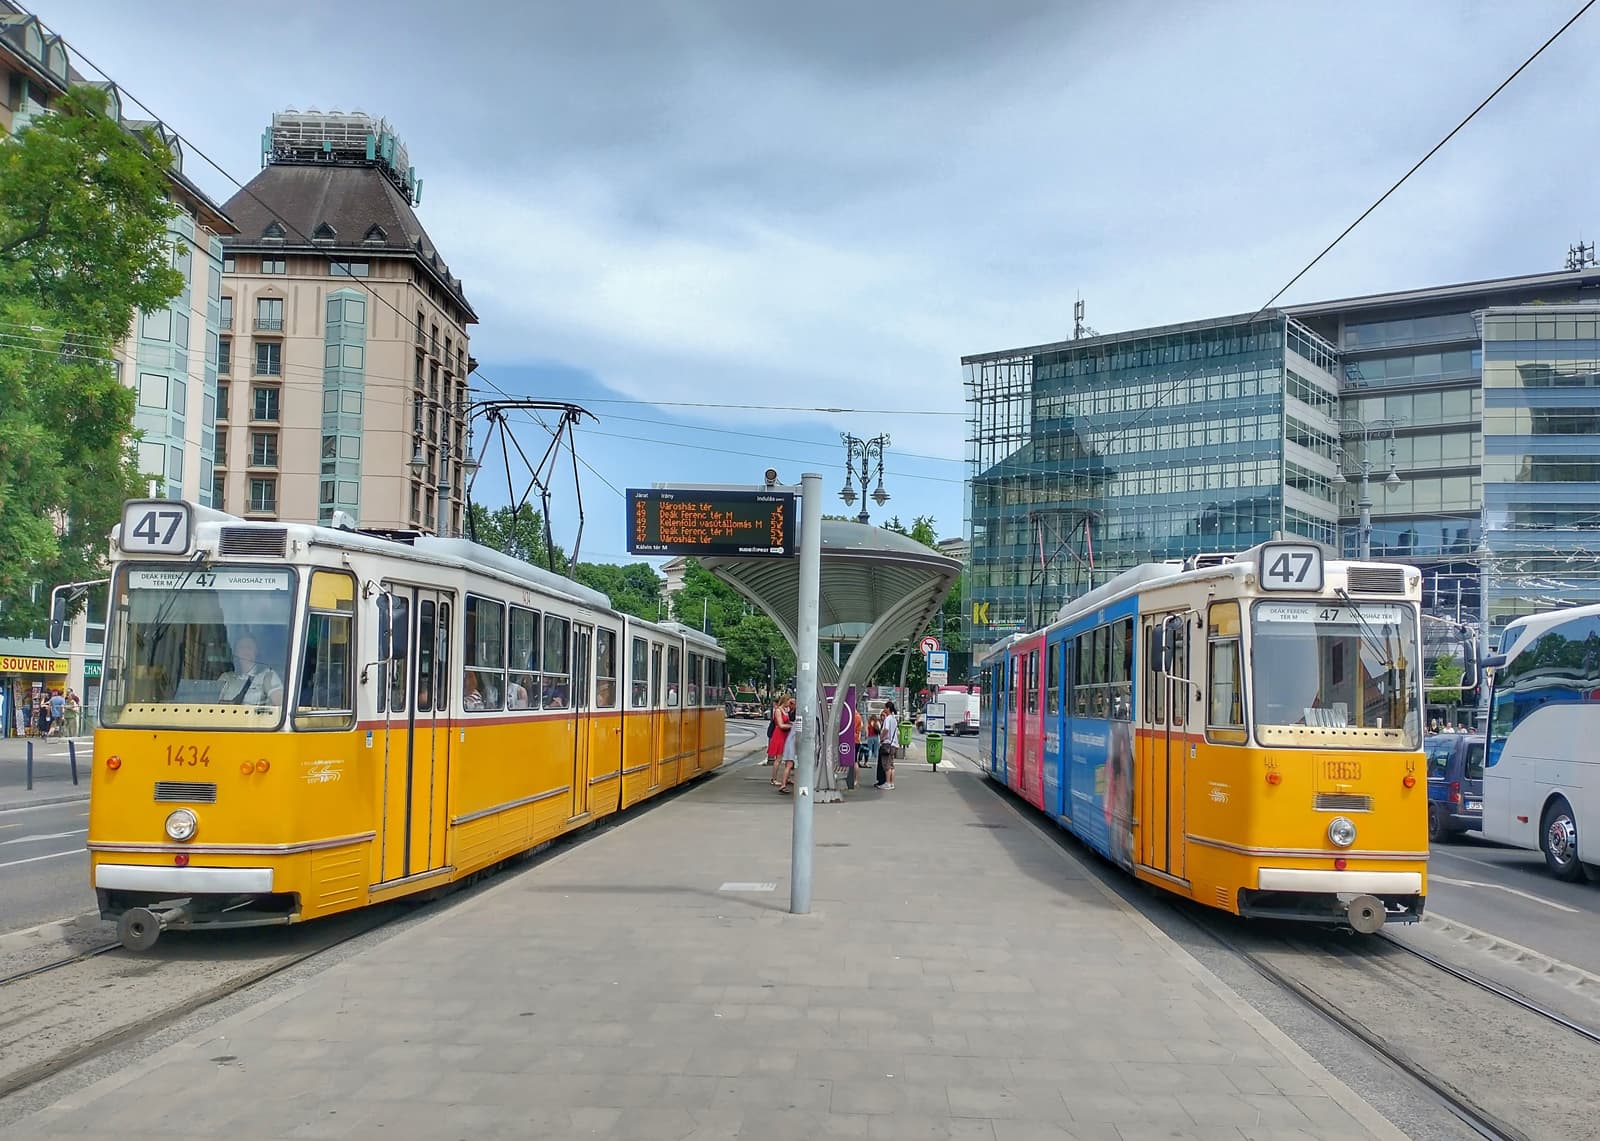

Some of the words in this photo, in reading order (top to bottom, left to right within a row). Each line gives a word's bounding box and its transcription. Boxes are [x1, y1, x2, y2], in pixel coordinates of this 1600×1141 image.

[700, 503, 713, 511] tér
[681, 511, 707, 520] Ferenc
[710, 512, 723, 520] tér
[726, 512, 733, 520] M
[133, 511, 183, 545] 47
[756, 520, 763, 529] M
[681, 527, 707, 536] Ferenc
[710, 528, 723, 536] tér
[726, 528, 733, 537] M
[700, 535, 713, 544] tér
[1268, 552, 1314, 583] 47
[196, 573, 217, 588] 47
[973, 602, 989, 625] K
[1319, 608, 1340, 621] 47
[2, 657, 55, 671] SOUVENIR
[167, 744, 210, 767] 1434
